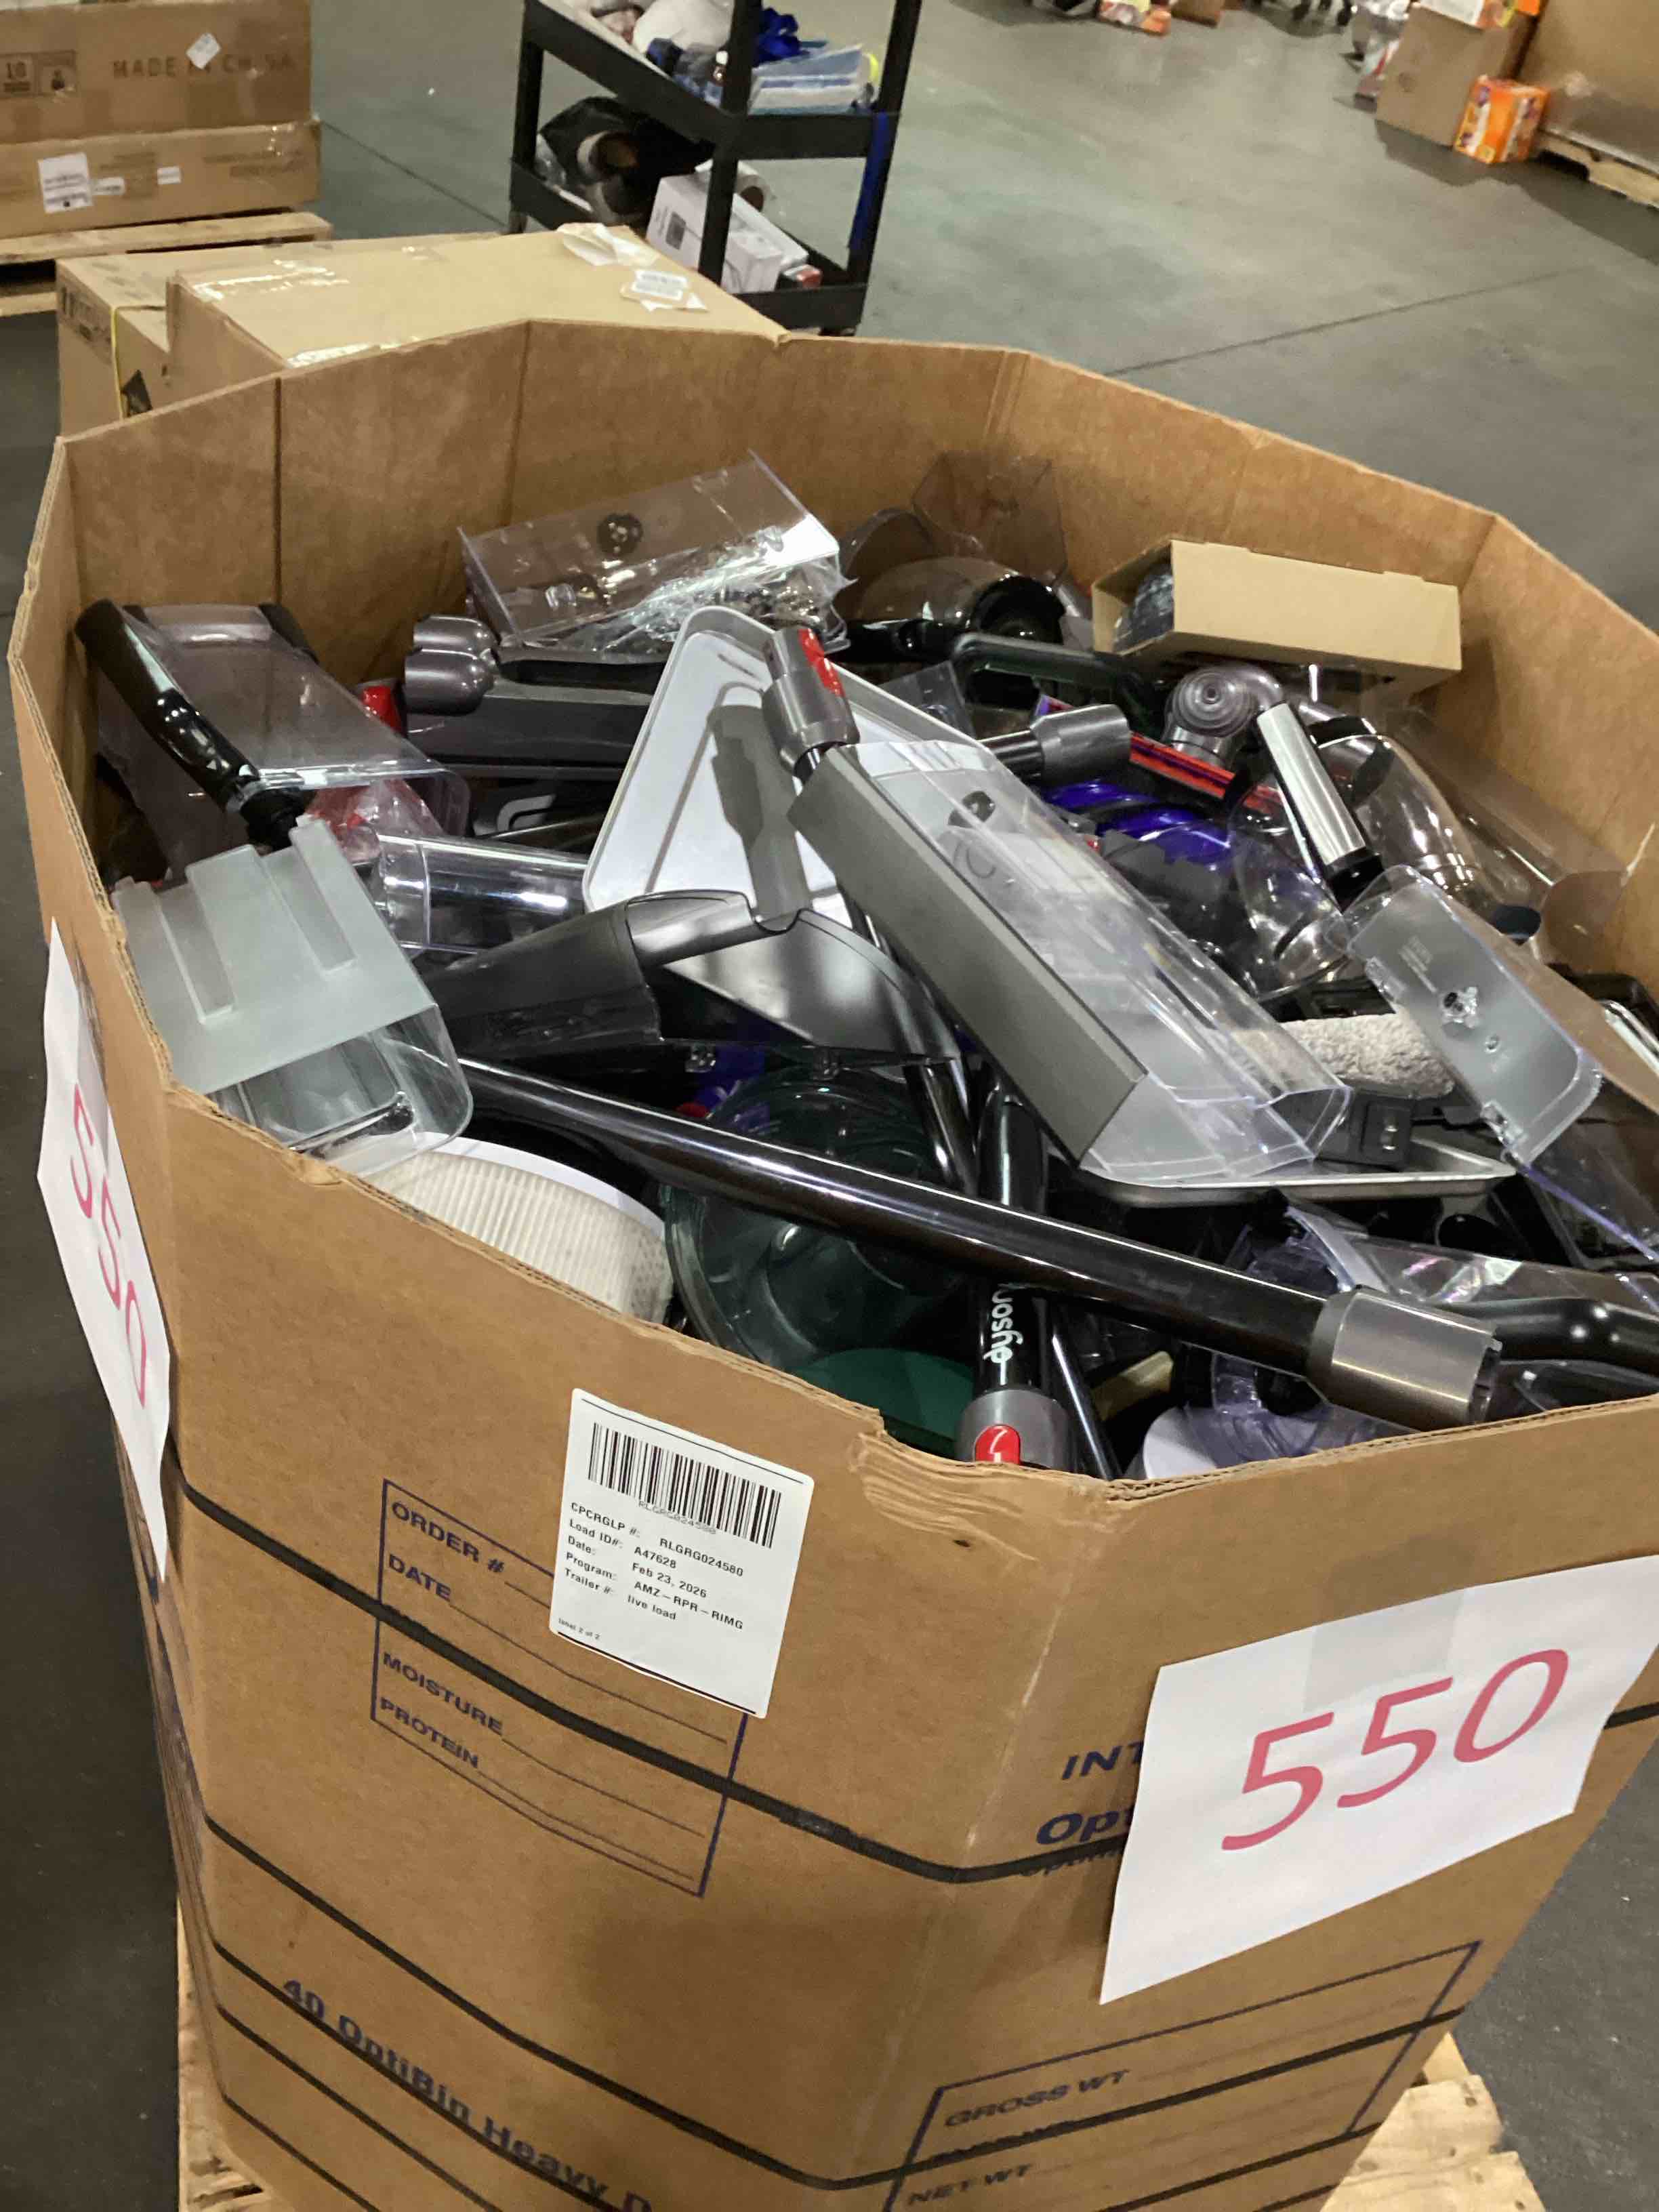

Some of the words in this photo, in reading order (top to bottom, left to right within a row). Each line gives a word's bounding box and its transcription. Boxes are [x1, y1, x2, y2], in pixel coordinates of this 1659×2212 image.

[112, 56, 178, 79] MADE
[70, 1083, 146, 1408] 550
[569, 1518, 595, 1538] Load
[571, 1502, 625, 1531] CPCRGLP
[392, 1500, 479, 1562] ORDER
[487, 1558, 505, 1574] #
[568, 1535, 596, 1555] Date:
[566, 1552, 617, 1580] Program:
[634, 1547, 677, 1569] A47628
[659, 1538, 743, 1577] RLGRG024580
[388, 1553, 451, 1601] DATE
[565, 1568, 600, 1591] Trailer
[632, 1562, 653, 1578] Feb
[657, 1572, 675, 1587] 23,
[679, 1580, 707, 1598] 2026
[627, 1595, 648, 1609] live
[652, 1604, 676, 1620] load
[383, 1652, 504, 1736] MOISTURE
[380, 1696, 479, 1768] PROTEIN
[1221, 1649, 1570, 1851] 550
[945, 2084, 1071, 2127] GROSS
[1078, 2069, 1130, 2093] WT
[907, 2177, 977, 2206] NET
[985, 2163, 1033, 2185] WT
